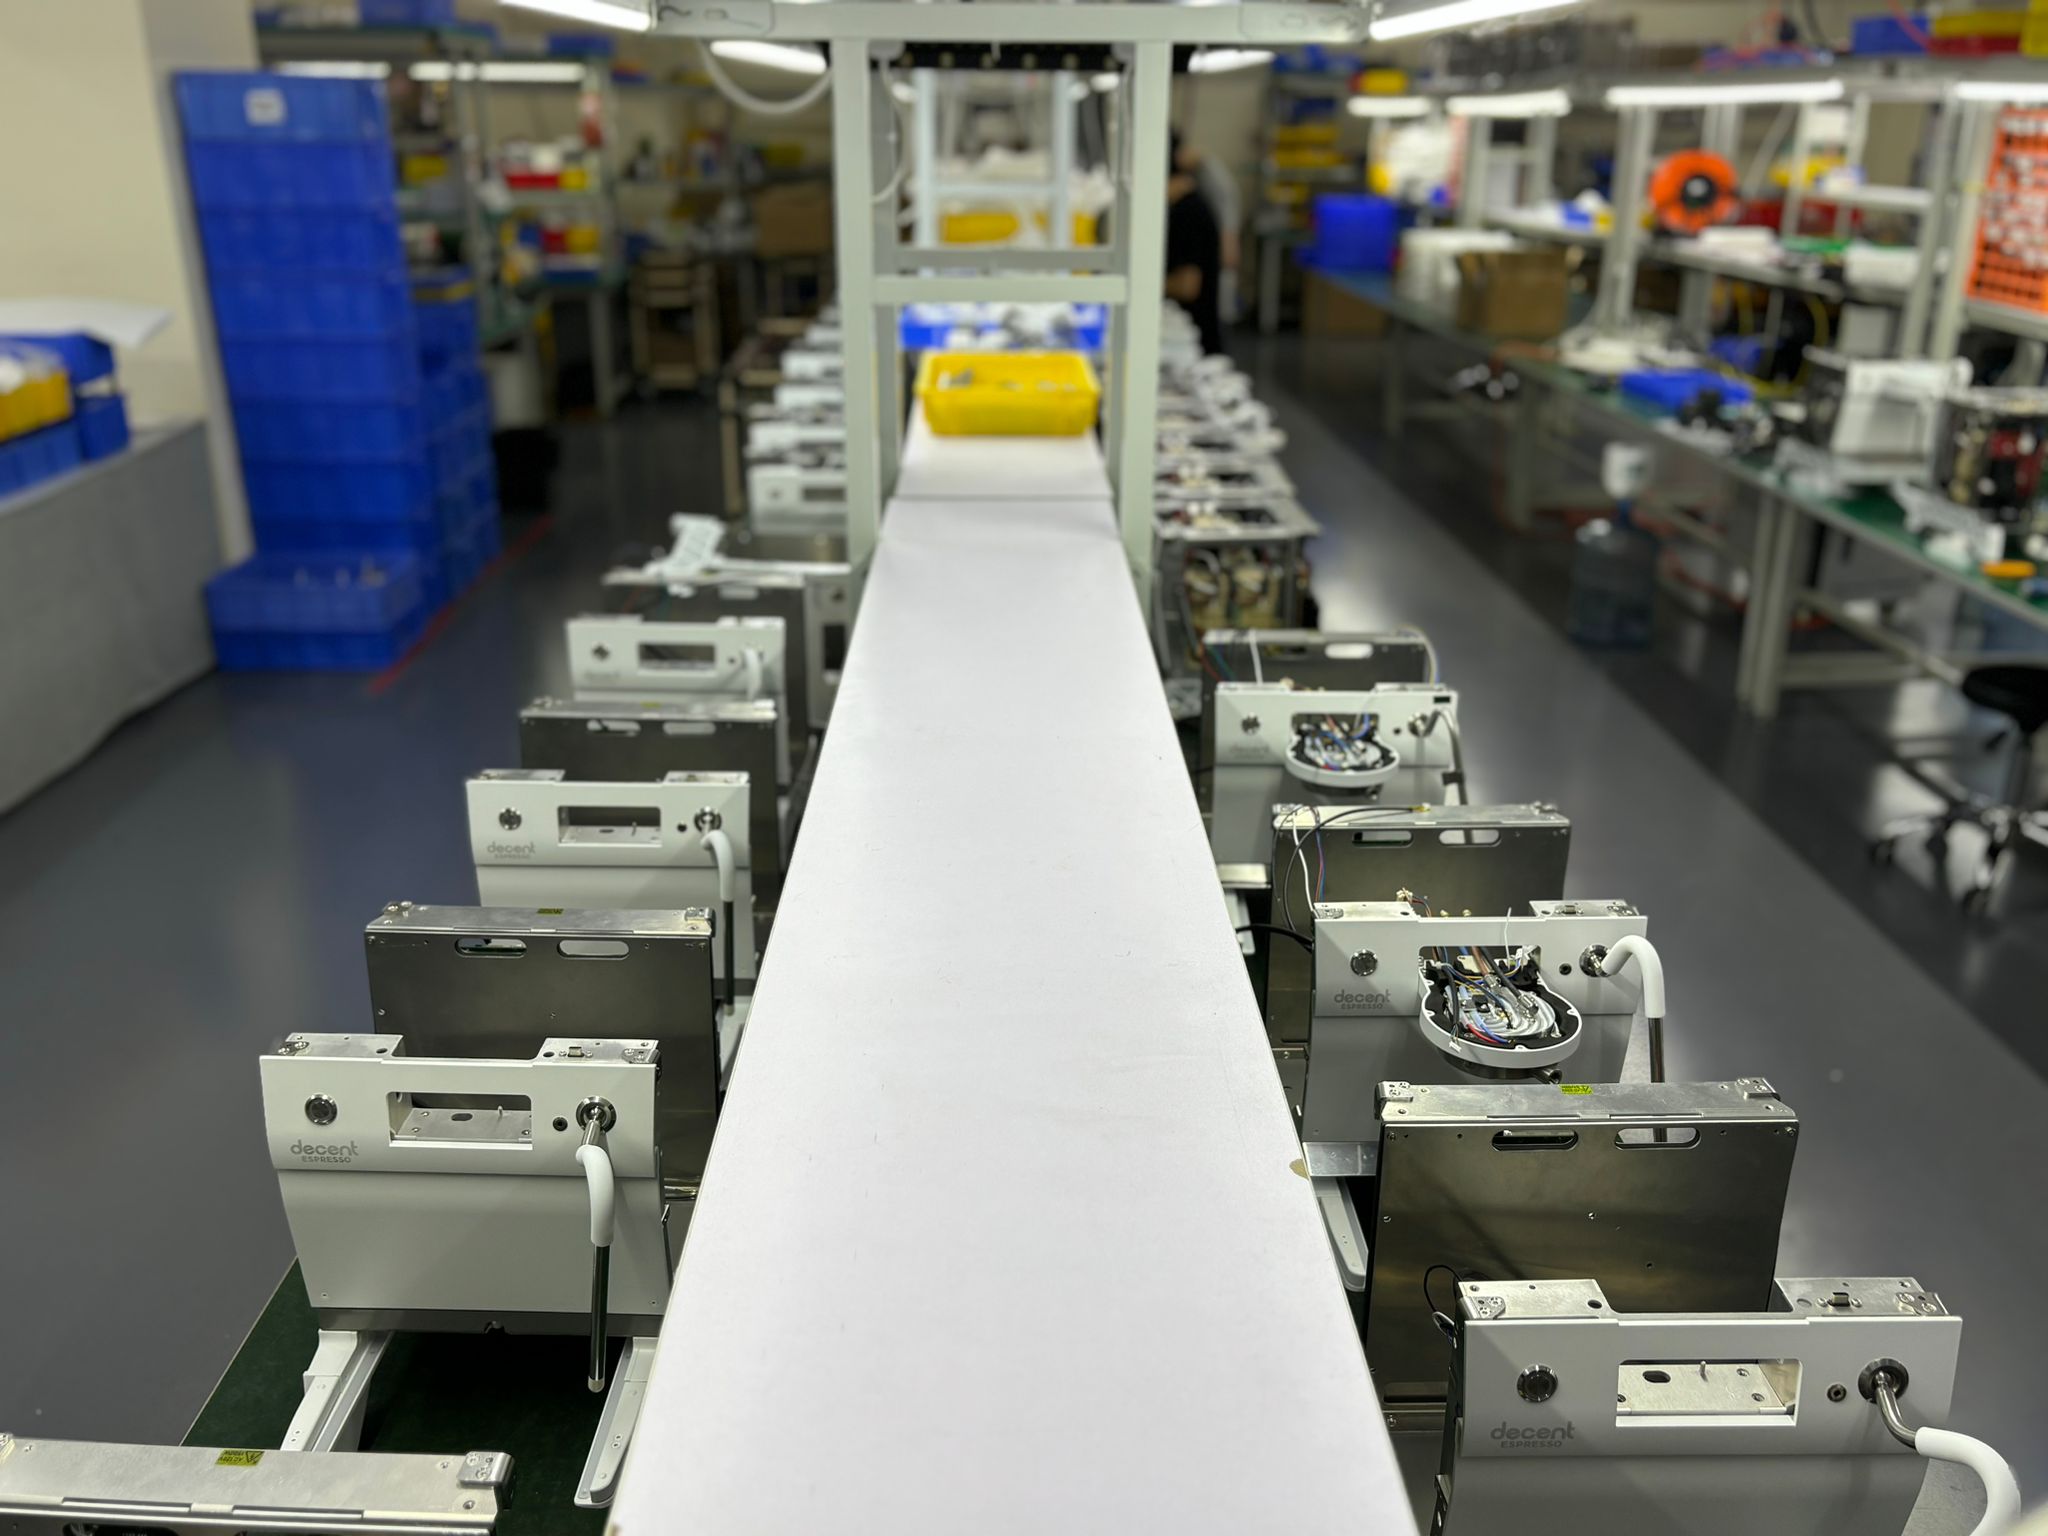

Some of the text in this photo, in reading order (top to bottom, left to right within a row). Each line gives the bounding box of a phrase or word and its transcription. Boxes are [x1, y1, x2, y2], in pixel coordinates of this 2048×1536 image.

[1334, 989, 1391, 1003] decent
[289, 1139, 359, 1156] decent
[302, 1155, 351, 1163] ESPRESSO
[1490, 1421, 1576, 1440] decent
[1501, 1440, 1562, 1448] ESPRESSO
